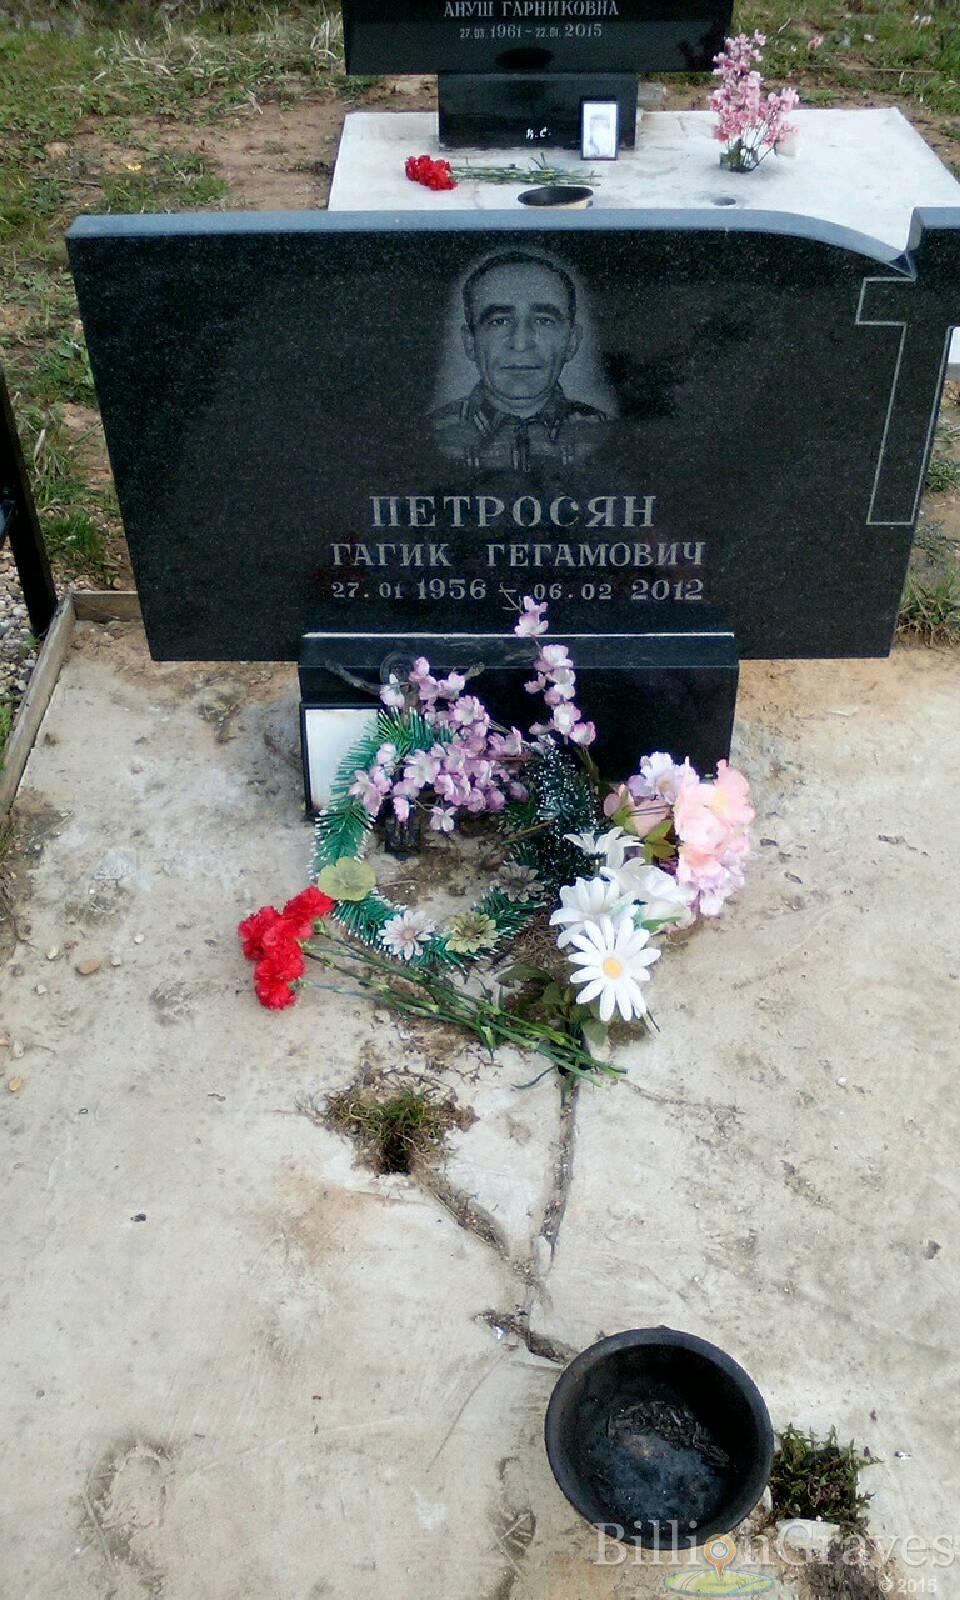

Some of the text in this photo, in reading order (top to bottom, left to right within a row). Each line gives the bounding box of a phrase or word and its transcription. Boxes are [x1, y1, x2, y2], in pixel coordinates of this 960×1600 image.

[444, 0, 619, 17] АНУШ ГАРНИКОВНА
[490, 24, 521, 38] 1961
[564, 23, 602, 37] 2015
[368, 495, 656, 528] ПЕТРОСЯН
[330, 541, 706, 568] ГАГИК ГЕГАМОВИЧ
[417, 577, 487, 600] 1956
[631, 578, 704, 600] 2012
